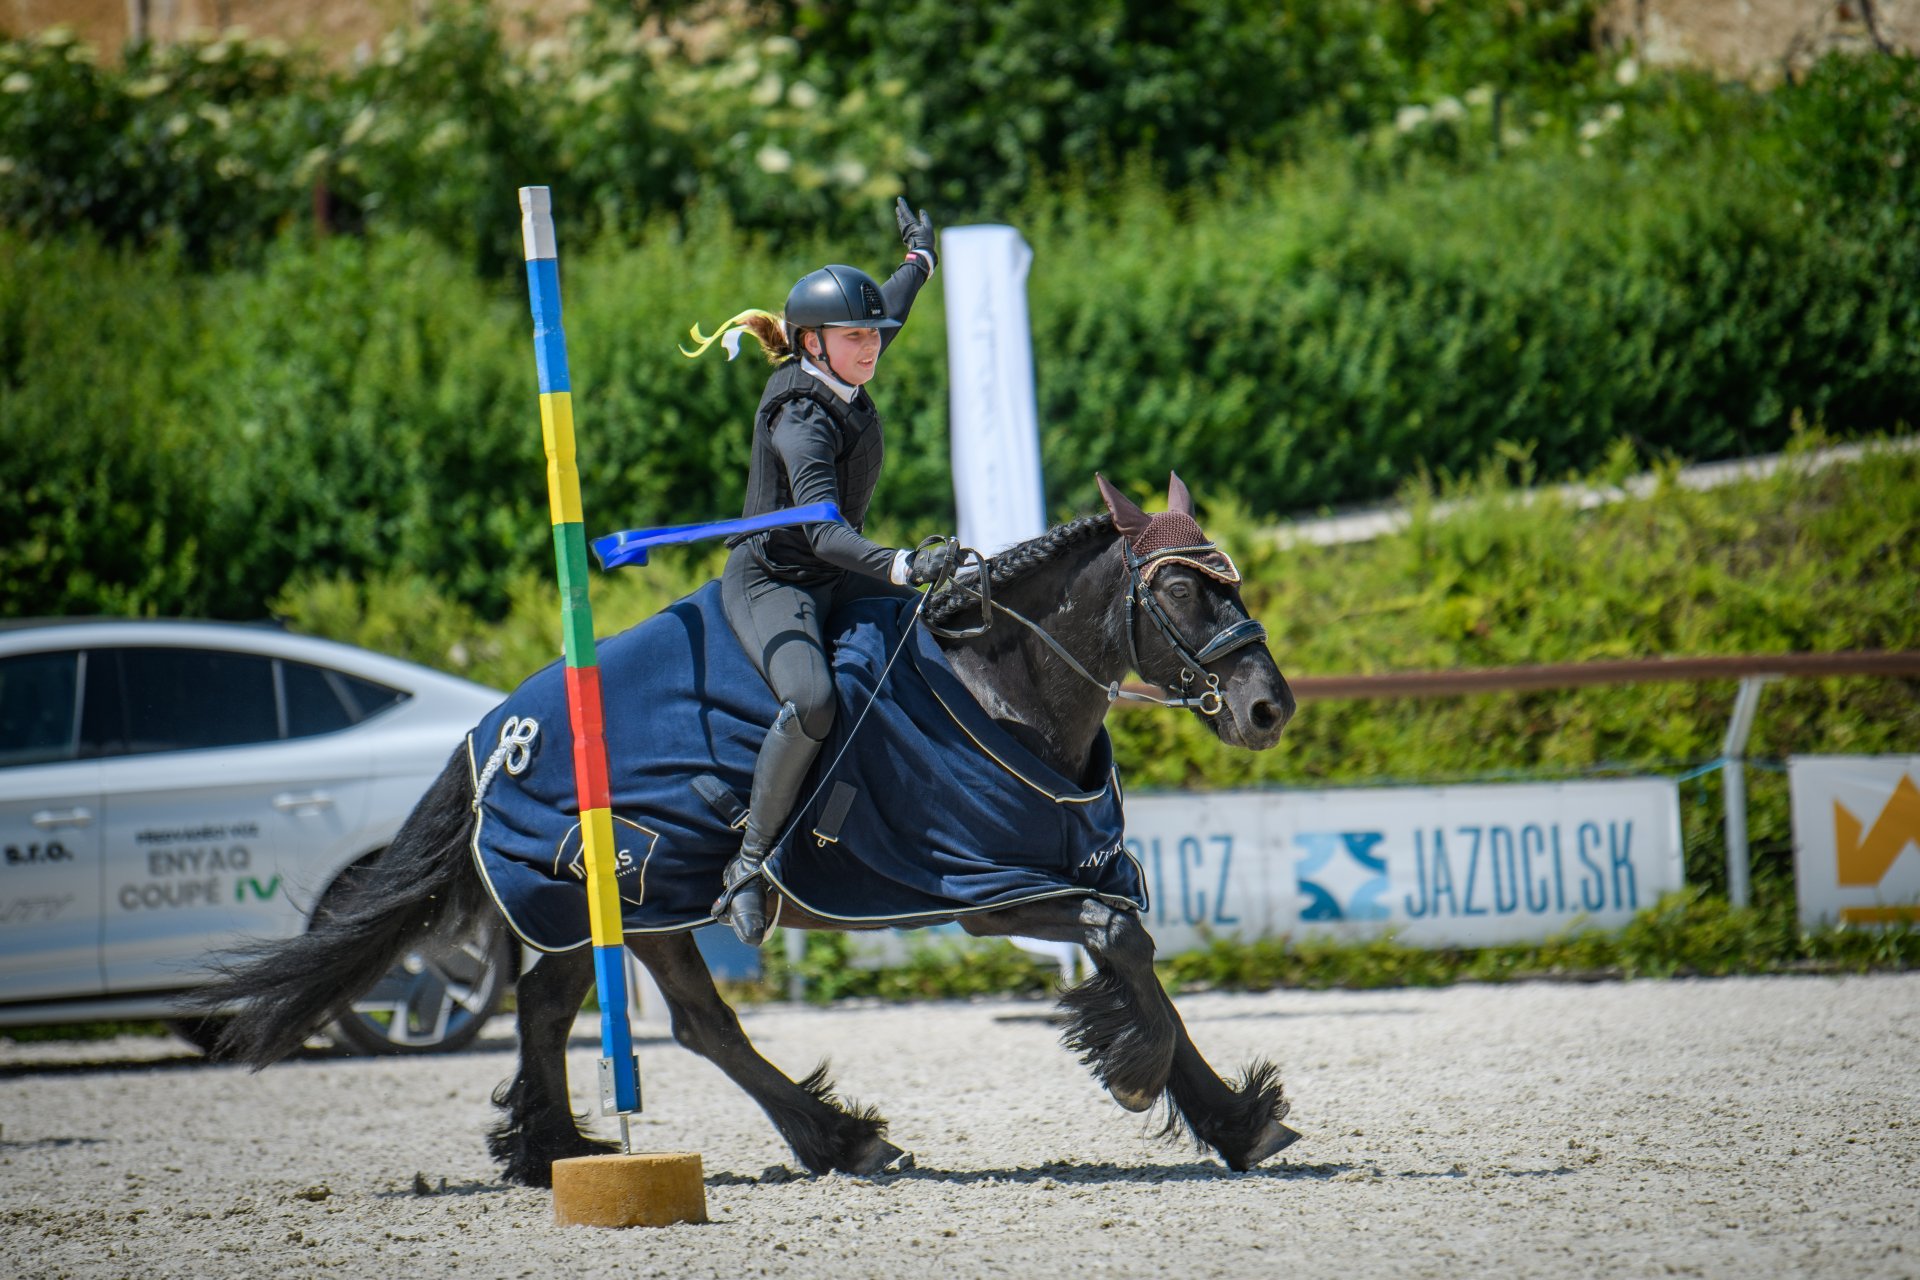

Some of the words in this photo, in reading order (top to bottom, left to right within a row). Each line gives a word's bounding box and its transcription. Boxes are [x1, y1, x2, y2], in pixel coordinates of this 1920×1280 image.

[5, 841, 73, 865] s.r.o.
[147, 845, 251, 876] ENYAQ
[1405, 820, 1638, 919] JAZDCI.SK
[118, 877, 222, 910] COUPÉ
